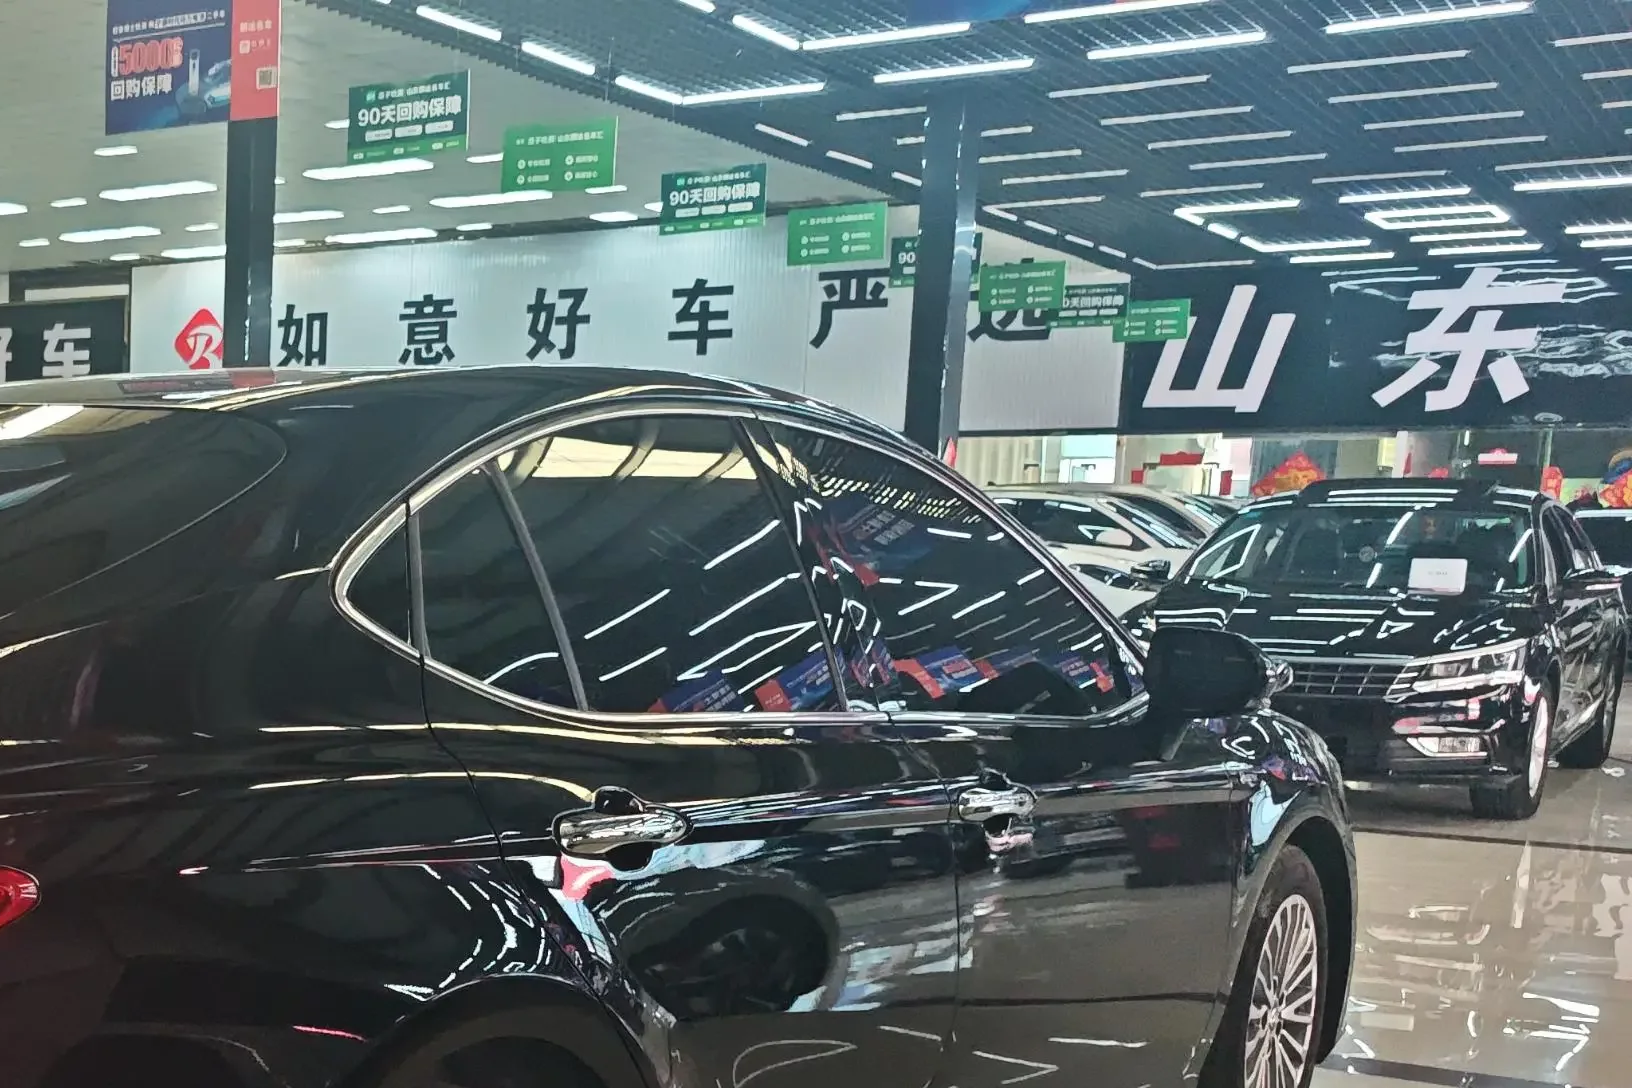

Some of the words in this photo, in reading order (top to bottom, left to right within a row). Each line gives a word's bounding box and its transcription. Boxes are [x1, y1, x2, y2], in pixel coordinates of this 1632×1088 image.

[111, 74, 172, 101] 回购保障
[358, 95, 462, 127] 90天回购保障
[669, 181, 760, 206] 90天回购保障
[1142, 266, 1571, 413] 山东
